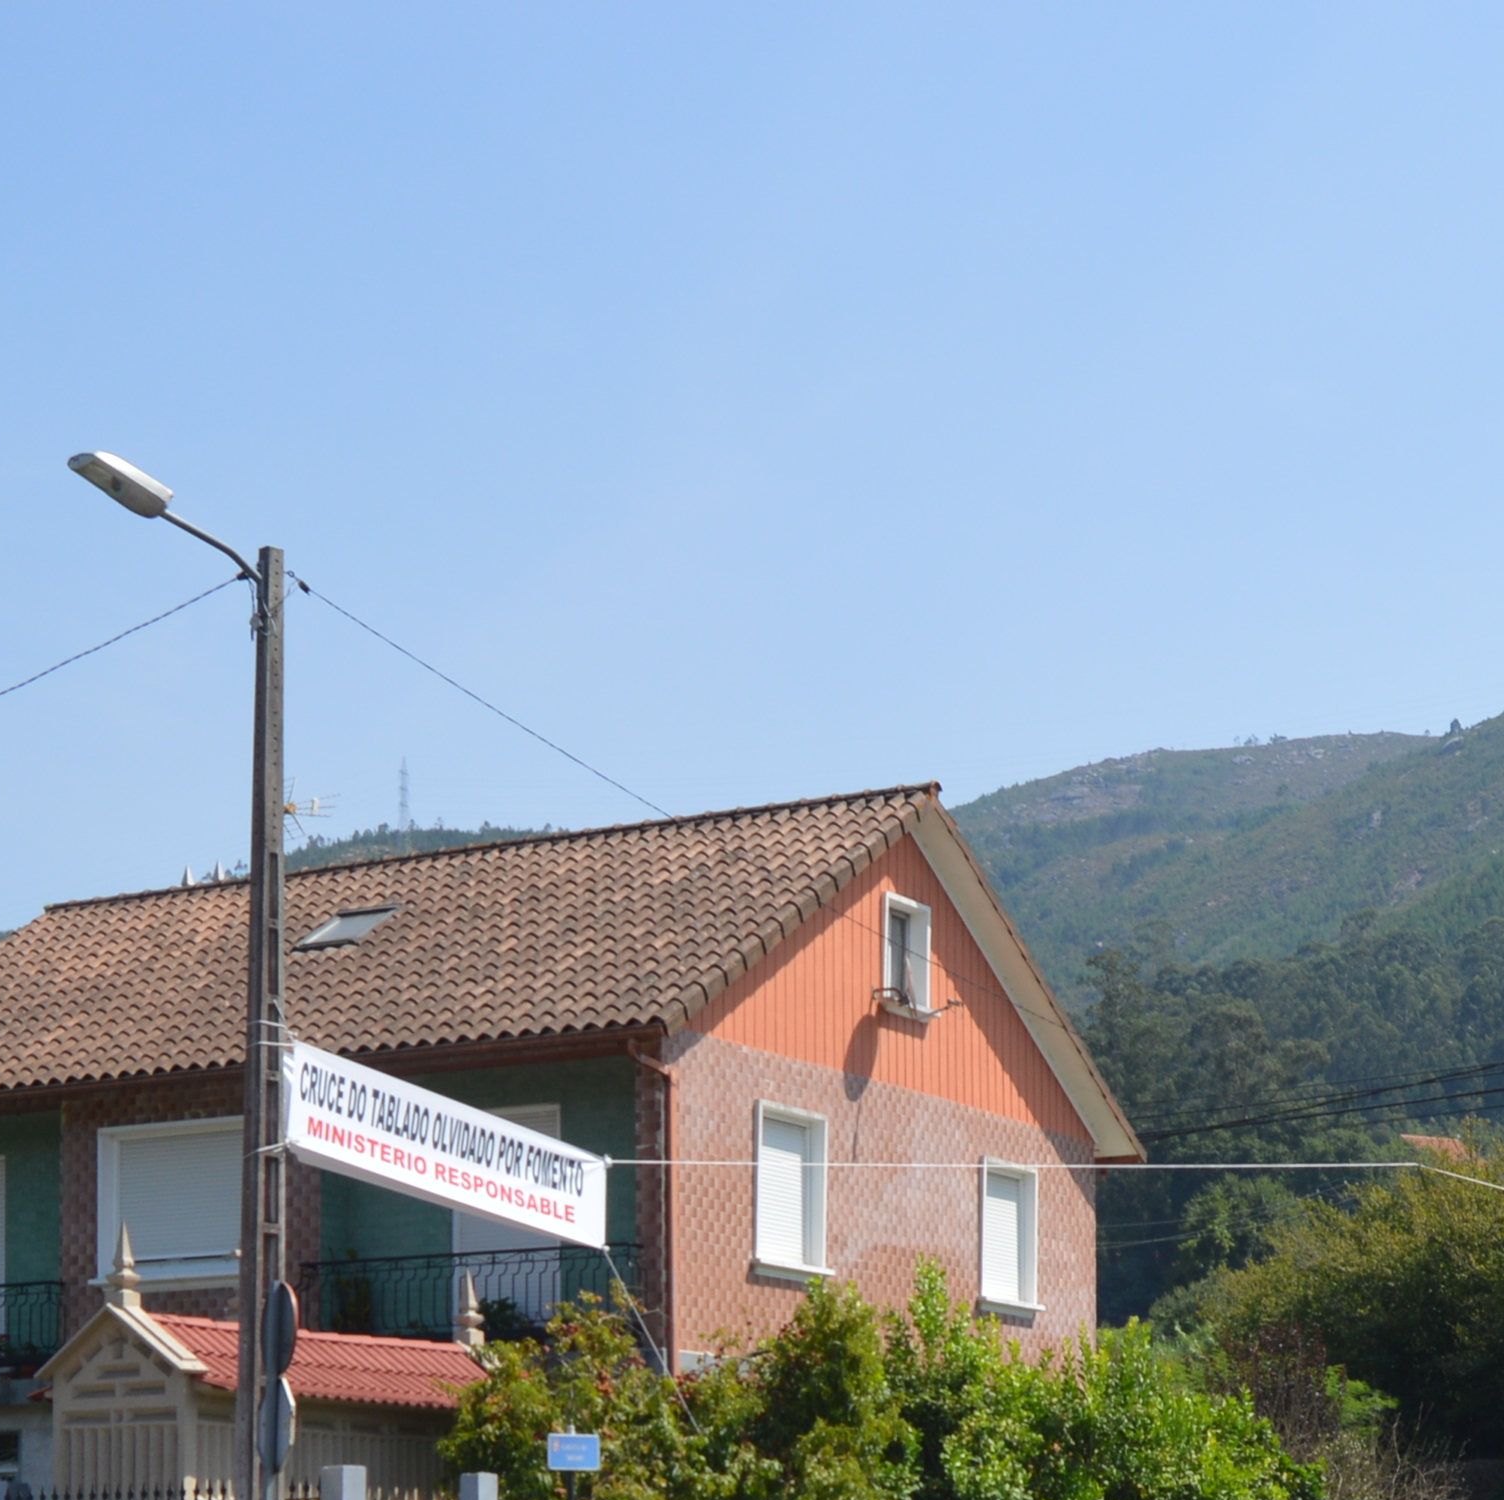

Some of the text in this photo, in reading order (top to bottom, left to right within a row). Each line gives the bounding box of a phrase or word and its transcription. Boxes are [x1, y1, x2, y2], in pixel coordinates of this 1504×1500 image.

[300, 1062, 584, 1197] CRUCE DO TABLADO OLVIDADO POR FOMENTO
[307, 1116, 576, 1224] MINISTERIO RESPONSABLE
